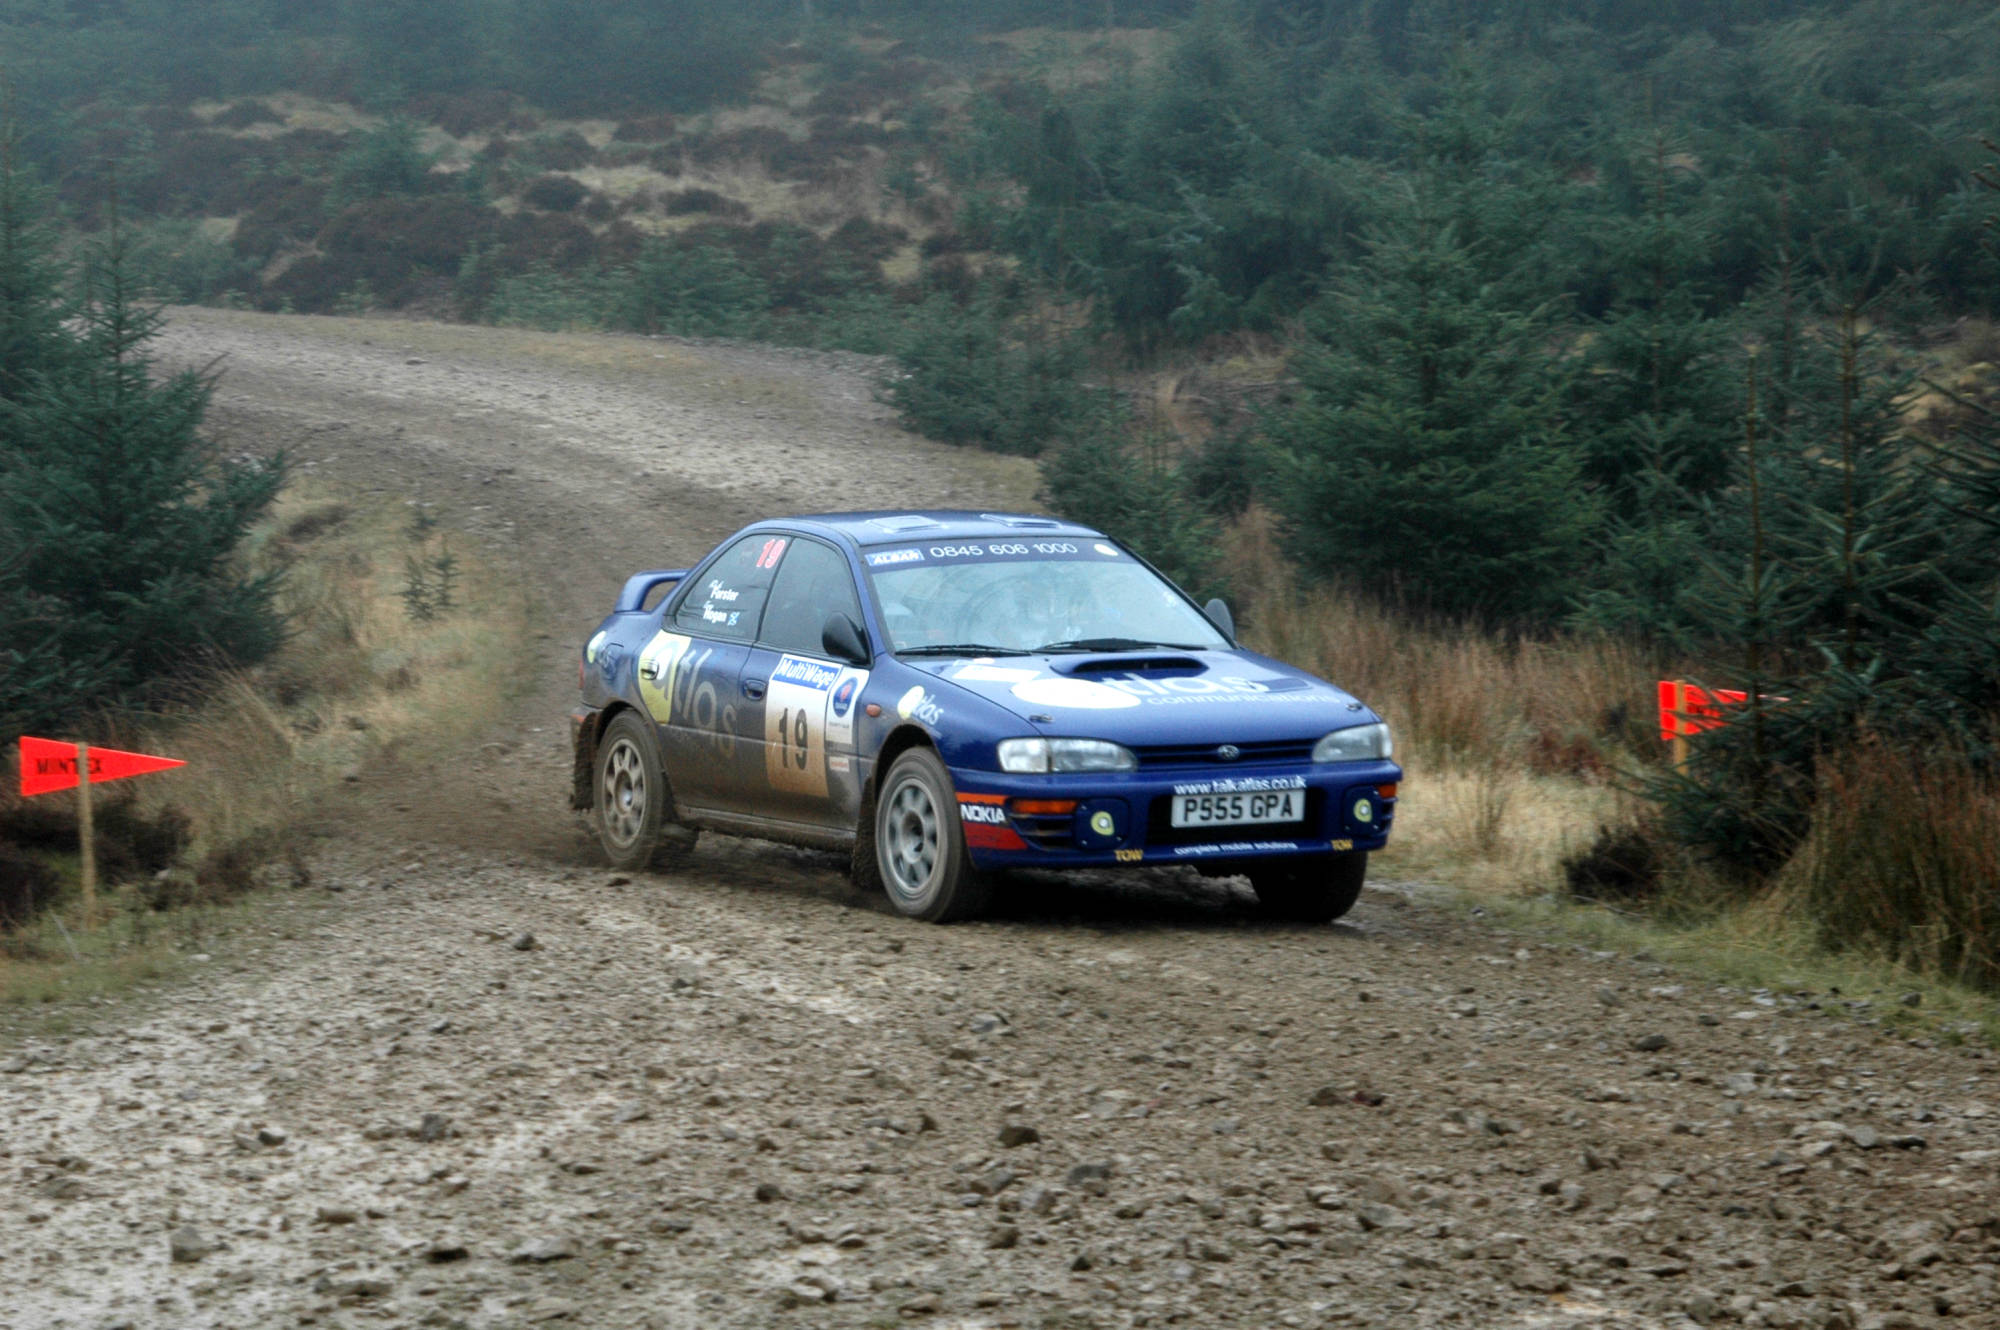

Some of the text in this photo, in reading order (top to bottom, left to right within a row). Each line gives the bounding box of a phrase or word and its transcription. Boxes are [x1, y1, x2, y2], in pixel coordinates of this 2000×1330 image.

[756, 539, 785, 568] 19
[930, 543, 1078, 557] 0845 606 1000
[776, 659, 835, 688] MultiWage
[779, 708, 808, 770] 19
[960, 804, 1006, 824] NOKIA
[1183, 793, 1293, 822] P555 GPA
[1114, 850, 1144, 862] TOW
[1331, 839, 1353, 851] TOW
